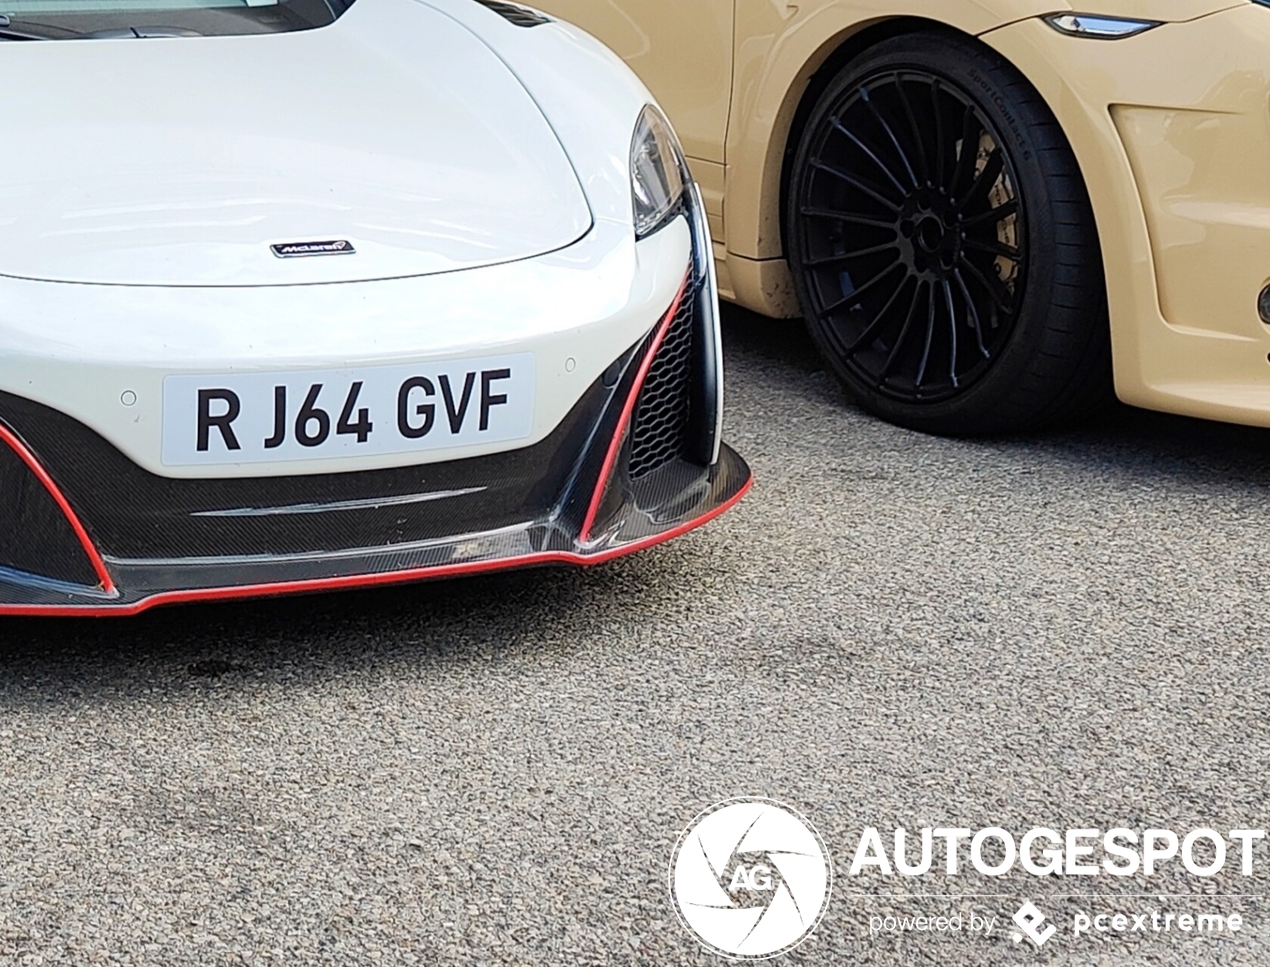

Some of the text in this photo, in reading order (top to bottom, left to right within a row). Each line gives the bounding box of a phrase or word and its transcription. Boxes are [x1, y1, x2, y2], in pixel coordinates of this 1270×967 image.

[281, 241, 343, 253] McLaren
[196, 368, 511, 452] R J64 GVF
